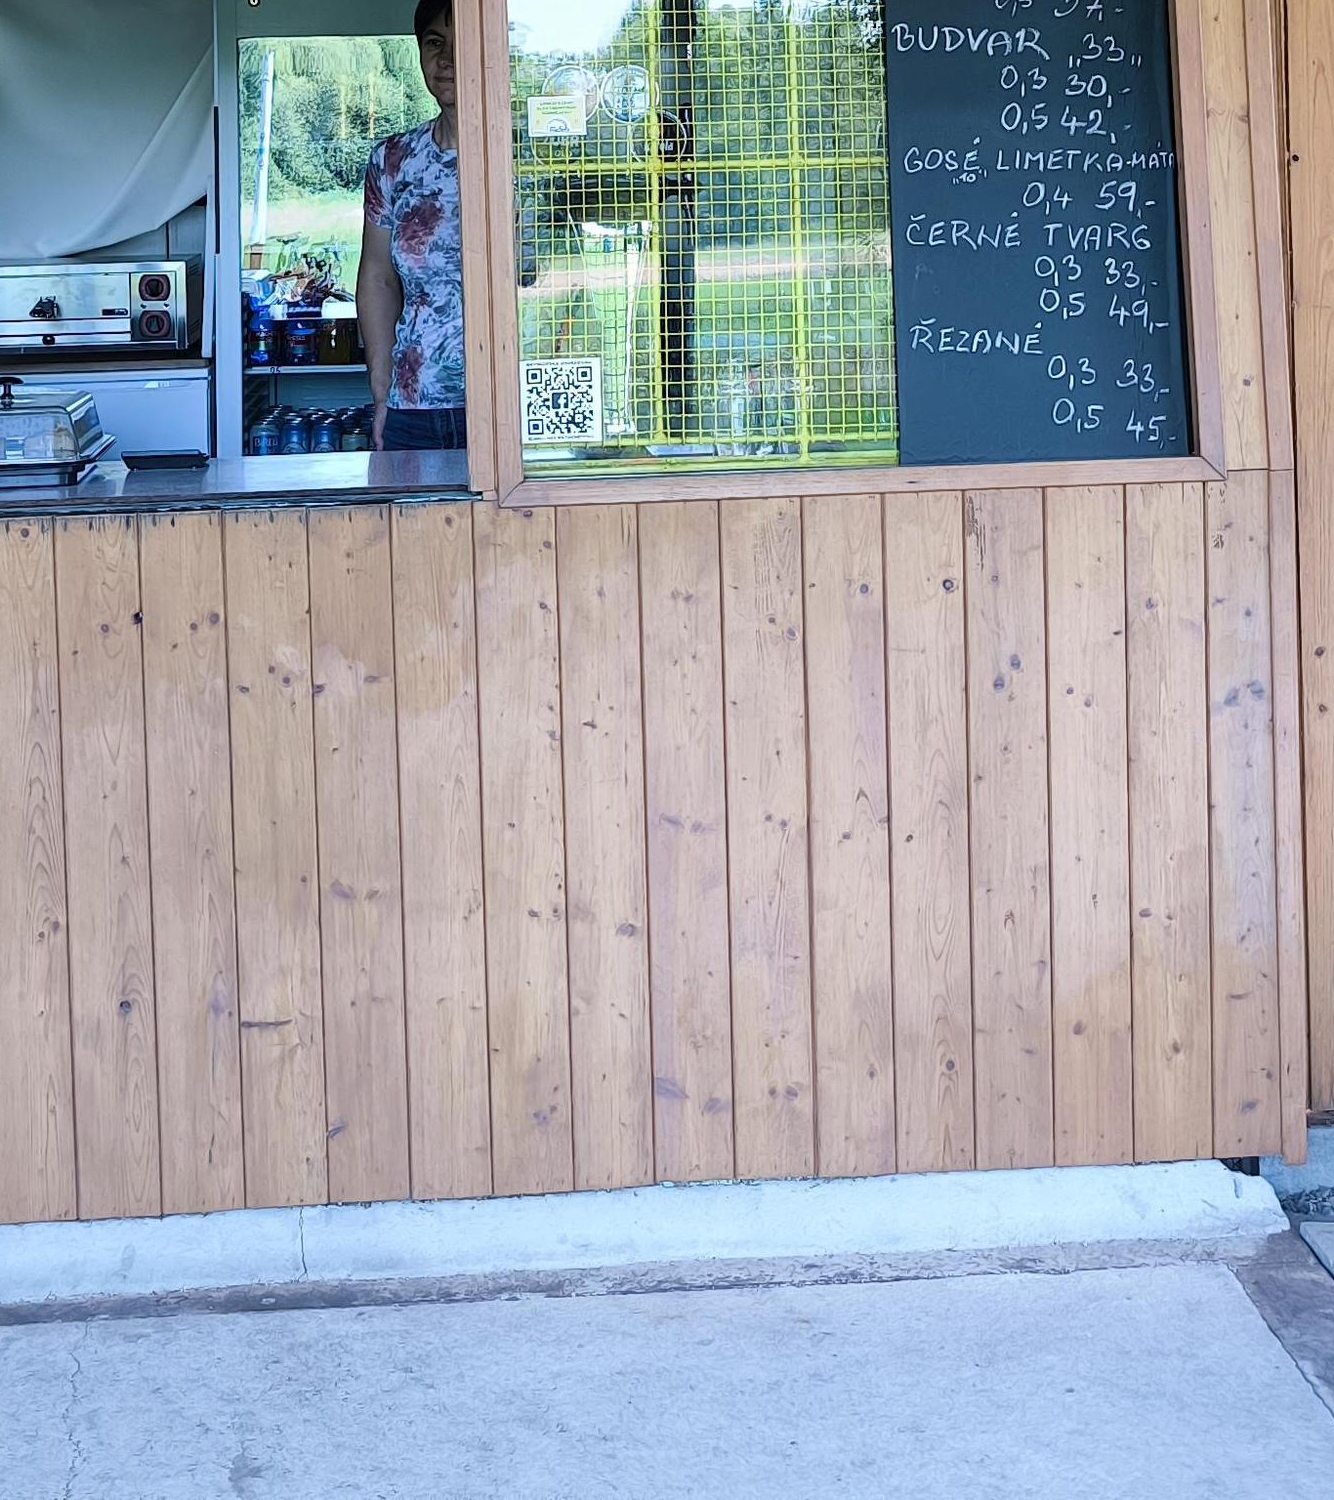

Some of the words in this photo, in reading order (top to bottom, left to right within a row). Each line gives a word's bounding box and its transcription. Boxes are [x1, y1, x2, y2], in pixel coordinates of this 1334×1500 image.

[890, 23, 1051, 61] BUDVAR
[999, 65, 1048, 98] 0,3
[999, 102, 1049, 136] 0,5
[1022, 181, 1074, 216] 0,4
[904, 211, 1022, 251] ČERNÉ
[1034, 254, 1083, 287] 0,3
[1038, 288, 1086, 321] 0,5
[910, 317, 1044, 355] ŘEZANÉ
[1047, 354, 1097, 391] 0,3
[1052, 397, 1105, 434] 0,5
